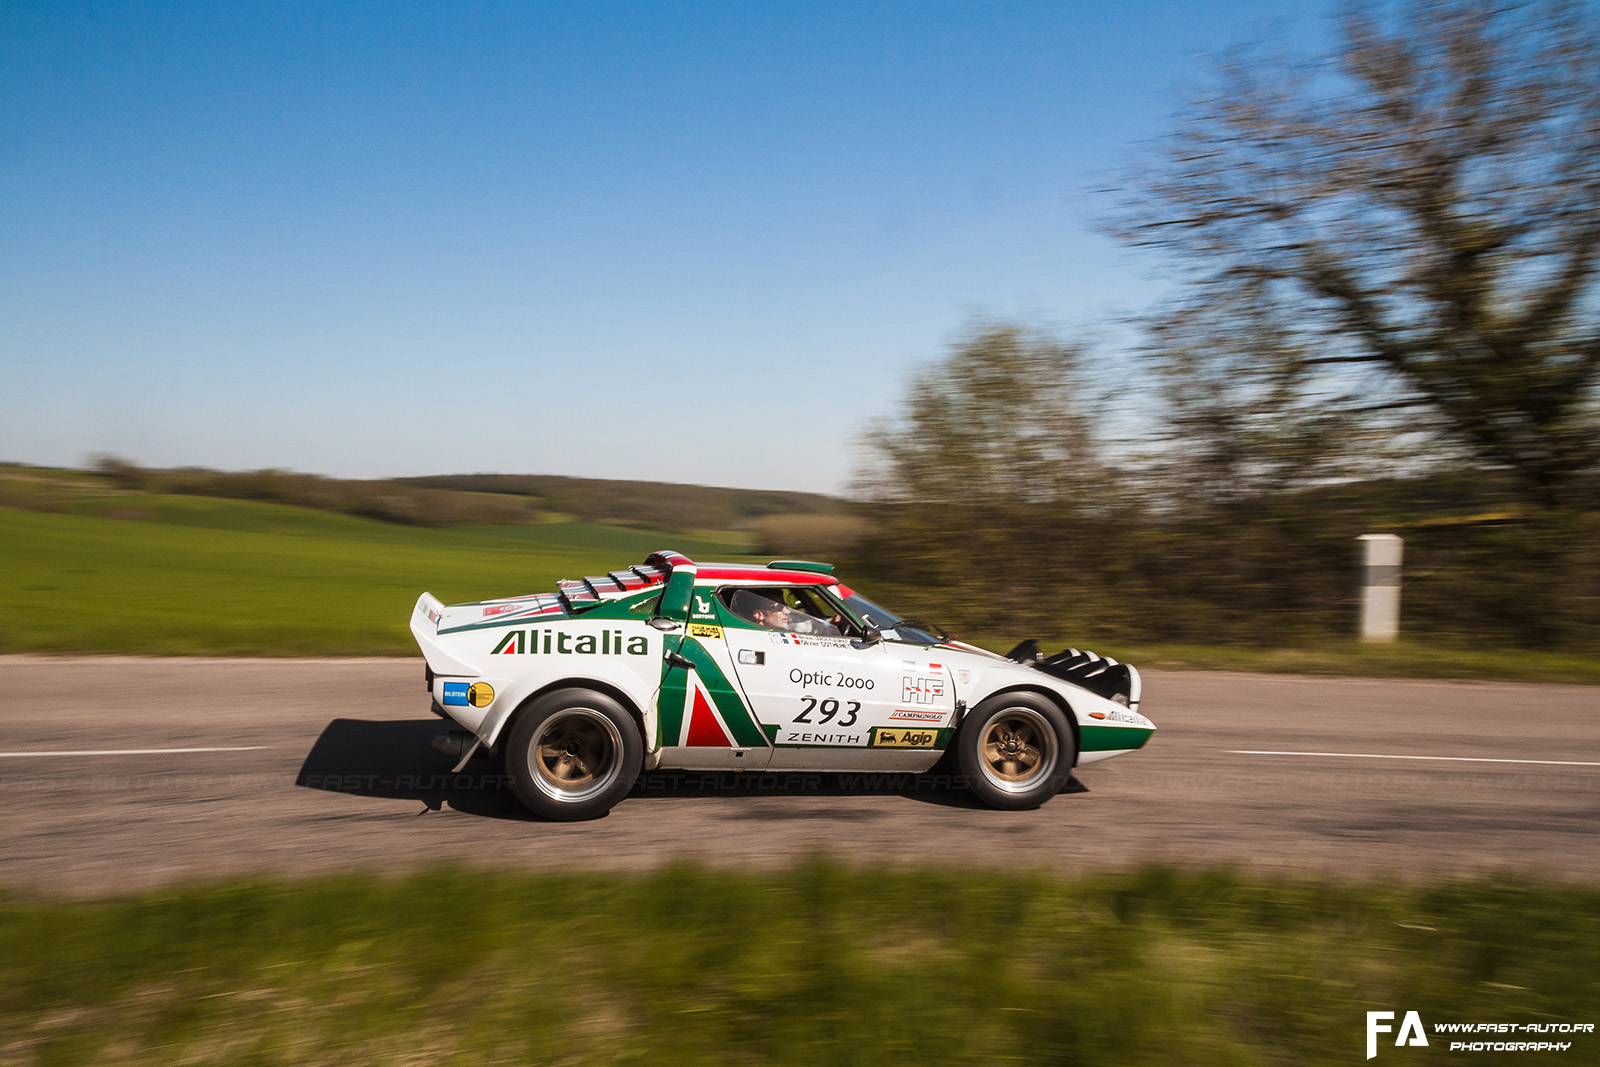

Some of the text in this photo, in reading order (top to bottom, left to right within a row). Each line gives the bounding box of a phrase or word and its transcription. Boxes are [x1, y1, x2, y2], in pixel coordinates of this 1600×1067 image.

[490, 629, 648, 655] Alitalia
[789, 668, 875, 690] Optic 2000
[444, 690, 467, 698] BILSTEIN
[901, 676, 943, 704] HF
[791, 695, 861, 727] 293
[898, 712, 943, 720] CAMPAGNOLO
[787, 732, 861, 744] ZENITH
[900, 731, 933, 746] Agip
